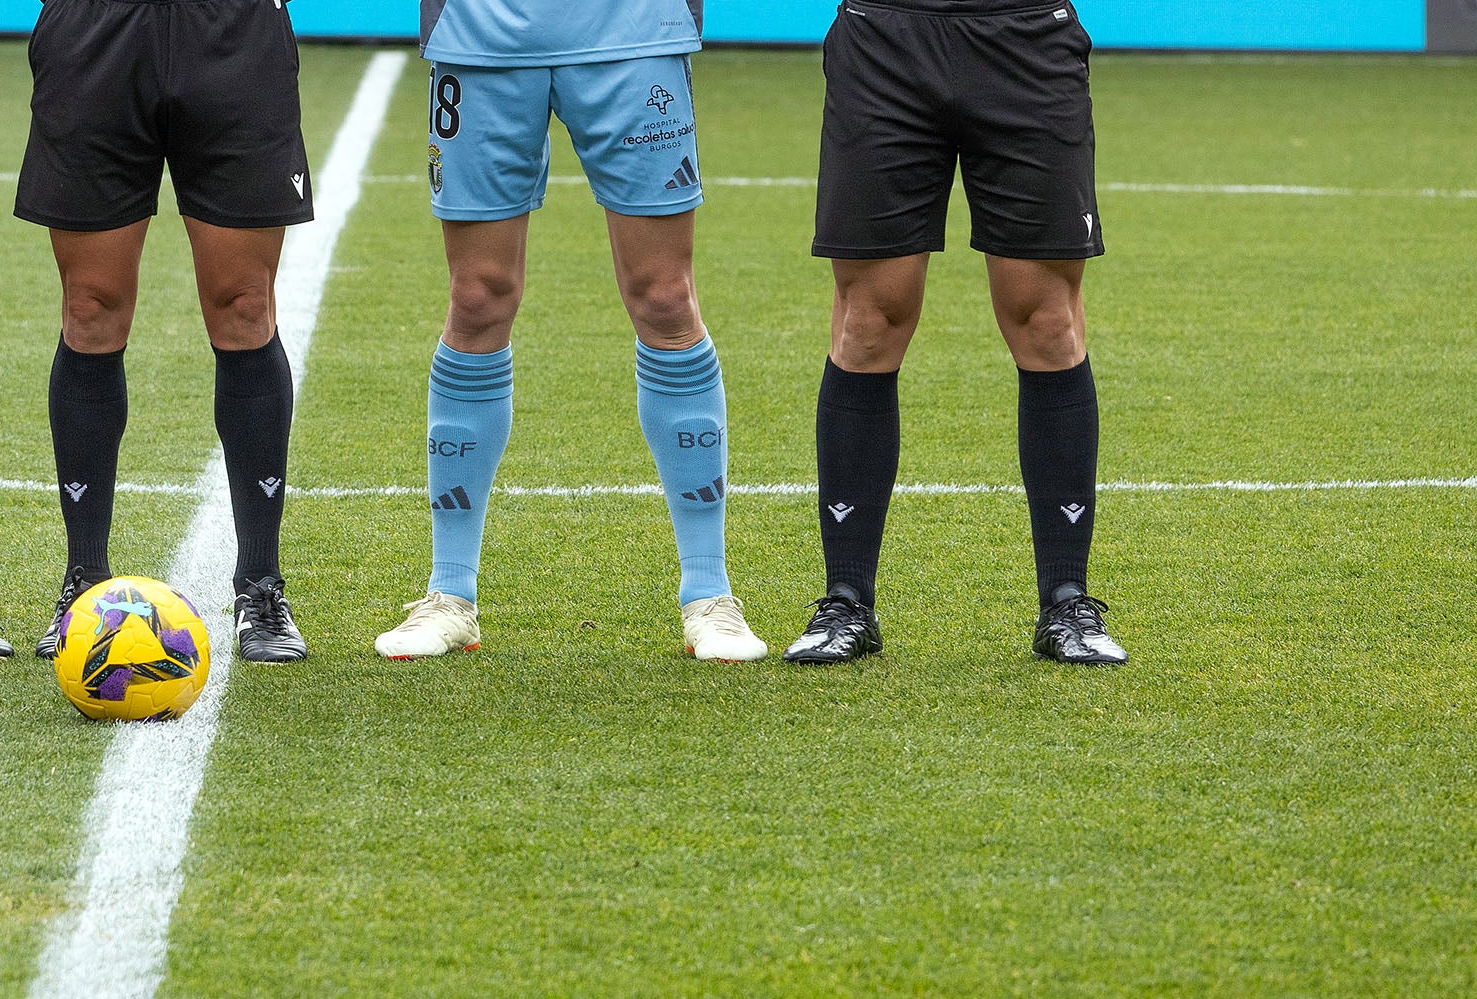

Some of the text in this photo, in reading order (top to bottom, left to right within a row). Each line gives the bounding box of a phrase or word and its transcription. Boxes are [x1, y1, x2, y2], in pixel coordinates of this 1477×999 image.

[643, 118, 681, 131] HOSPITAL
[622, 129, 676, 146] recoletas
[649, 141, 682, 152] BURGOS
